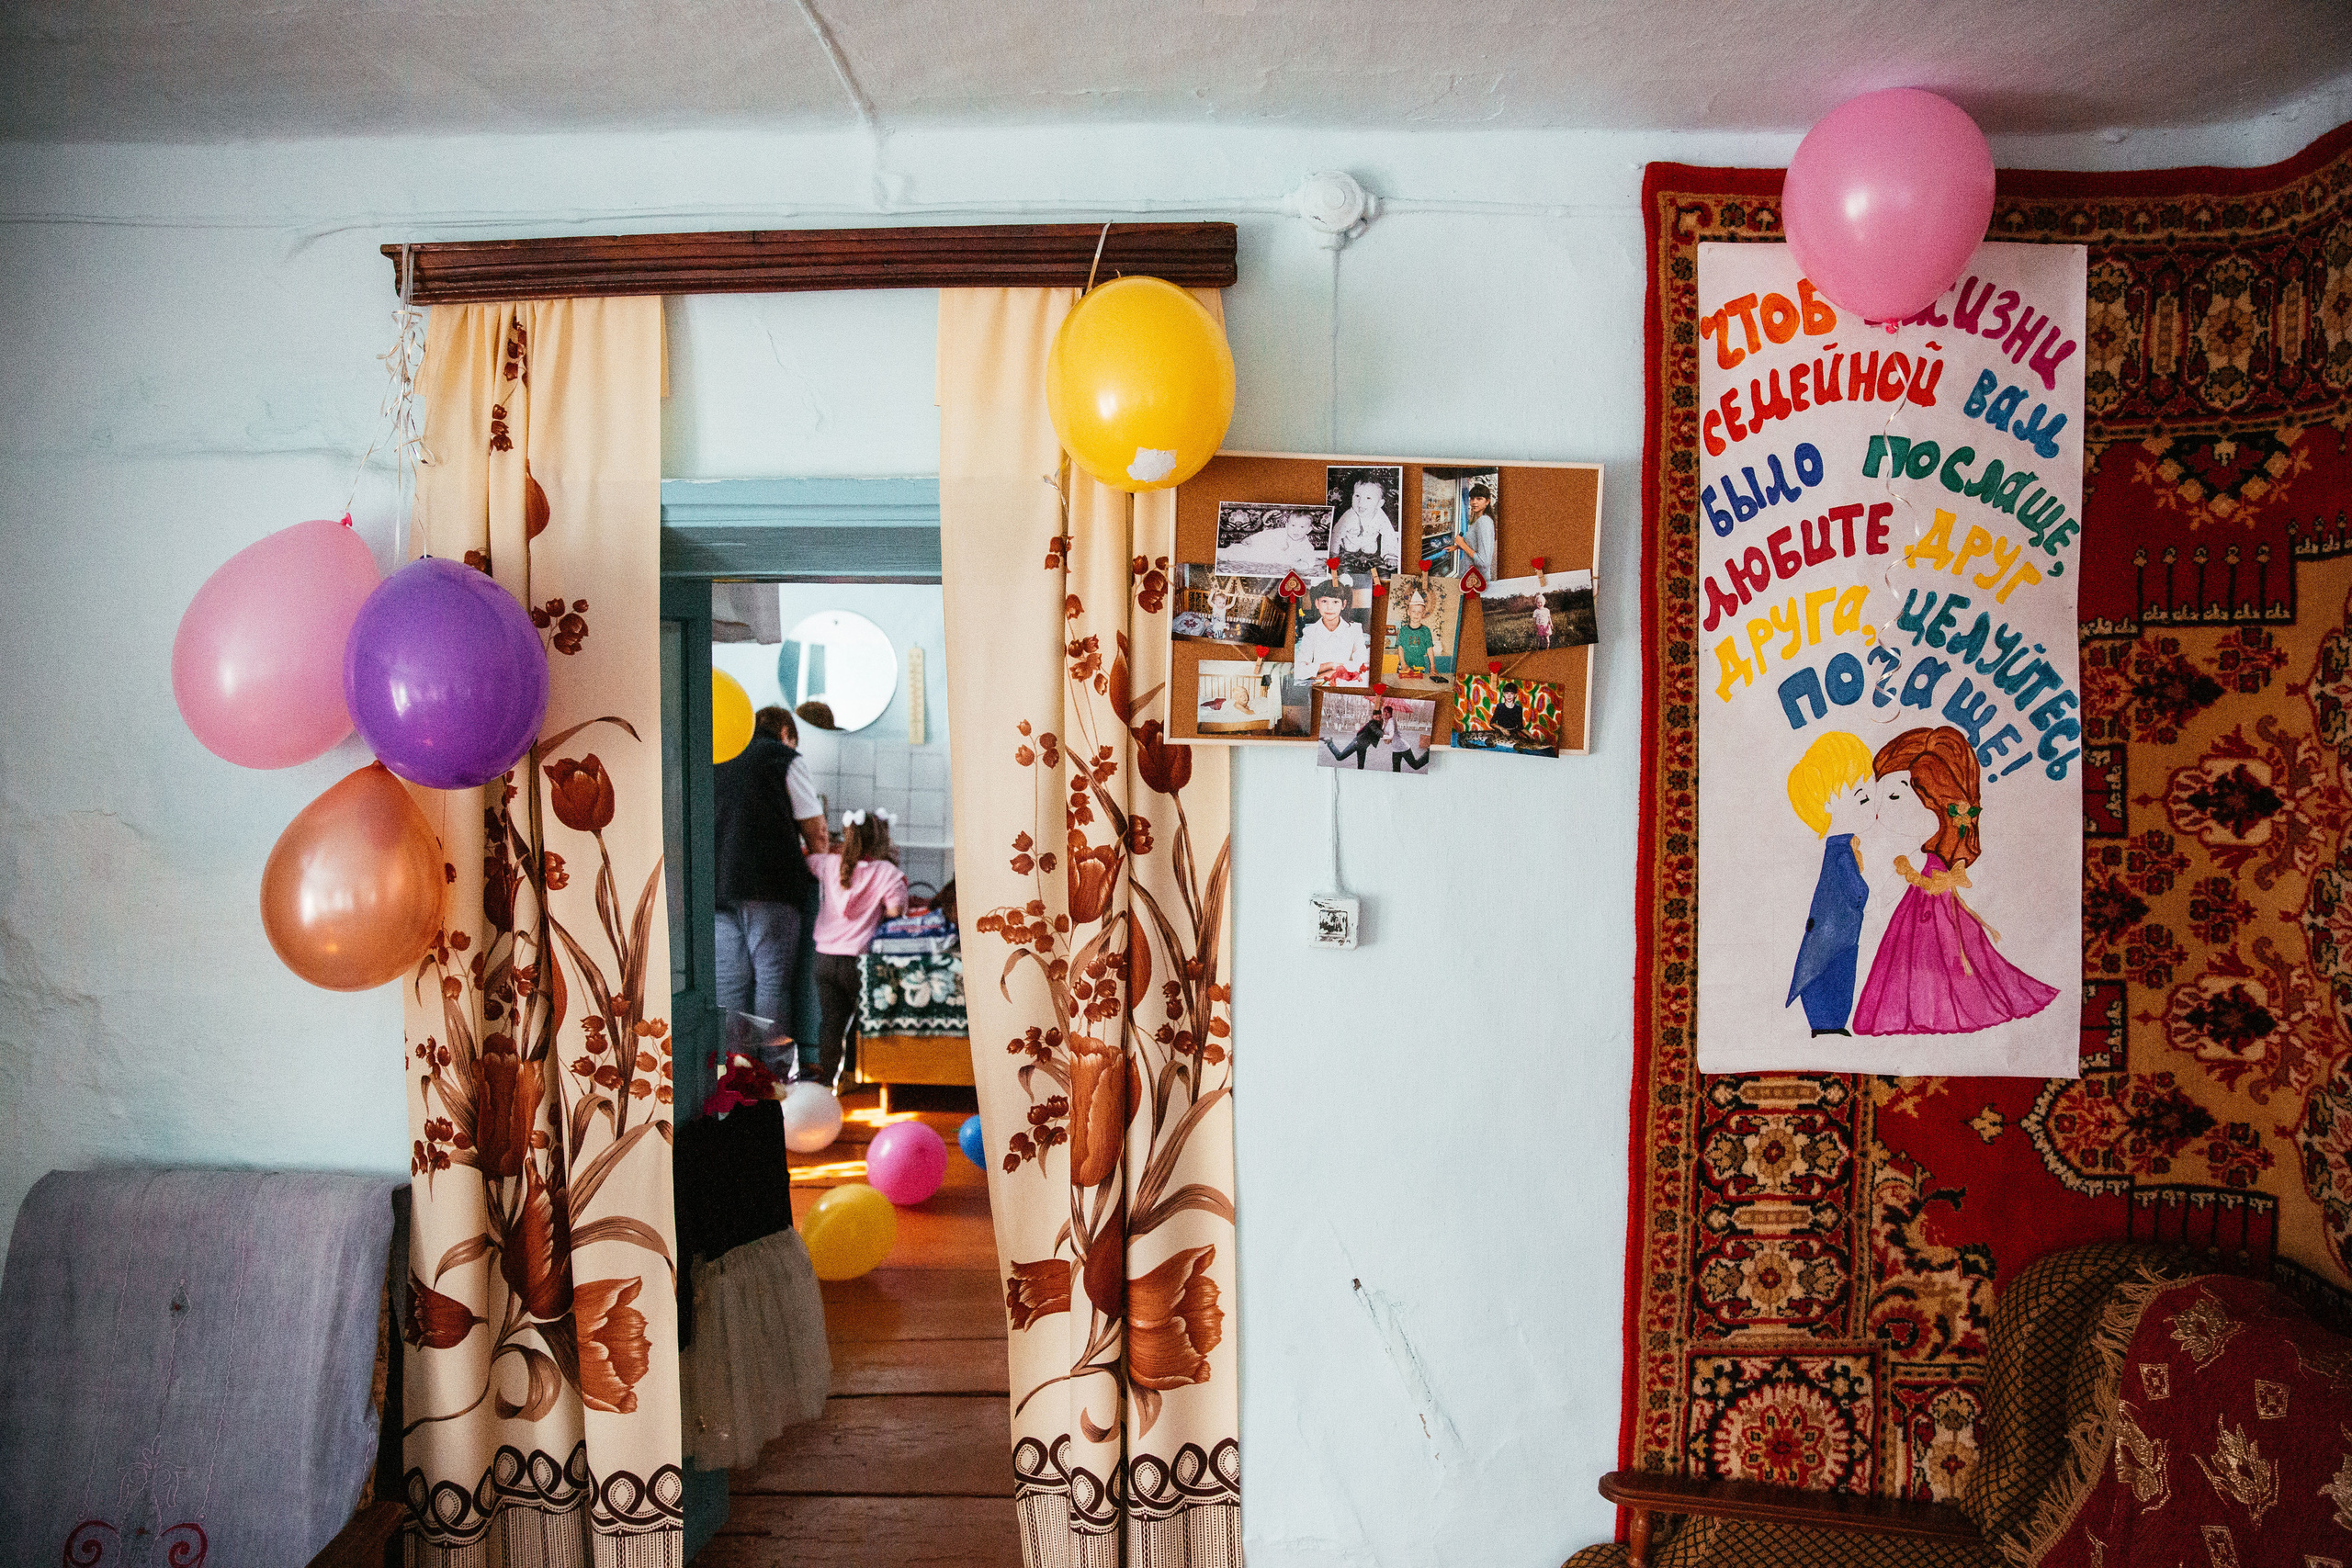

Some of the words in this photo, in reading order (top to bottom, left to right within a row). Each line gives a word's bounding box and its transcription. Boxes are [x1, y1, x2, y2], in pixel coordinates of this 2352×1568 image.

[1700, 277, 1837, 370] ЧТОБ
[1703, 341, 1944, 457] СЕМЕЙНОЙ
[1963, 368, 2068, 458] ВАМ
[1701, 443, 1824, 537] БЫЛО
[1862, 434, 2081, 578] ПОСЛАЩЕ,
[1703, 502, 1894, 632] ЛЮБИТЕ
[1904, 507, 2042, 604] ДРУГ
[1713, 584, 1877, 704] ДРУГА,
[1896, 588, 2082, 782] ЦЕЛУЙТЕСЬ
[1777, 645, 2033, 784] ПОЧАЩЕ!
